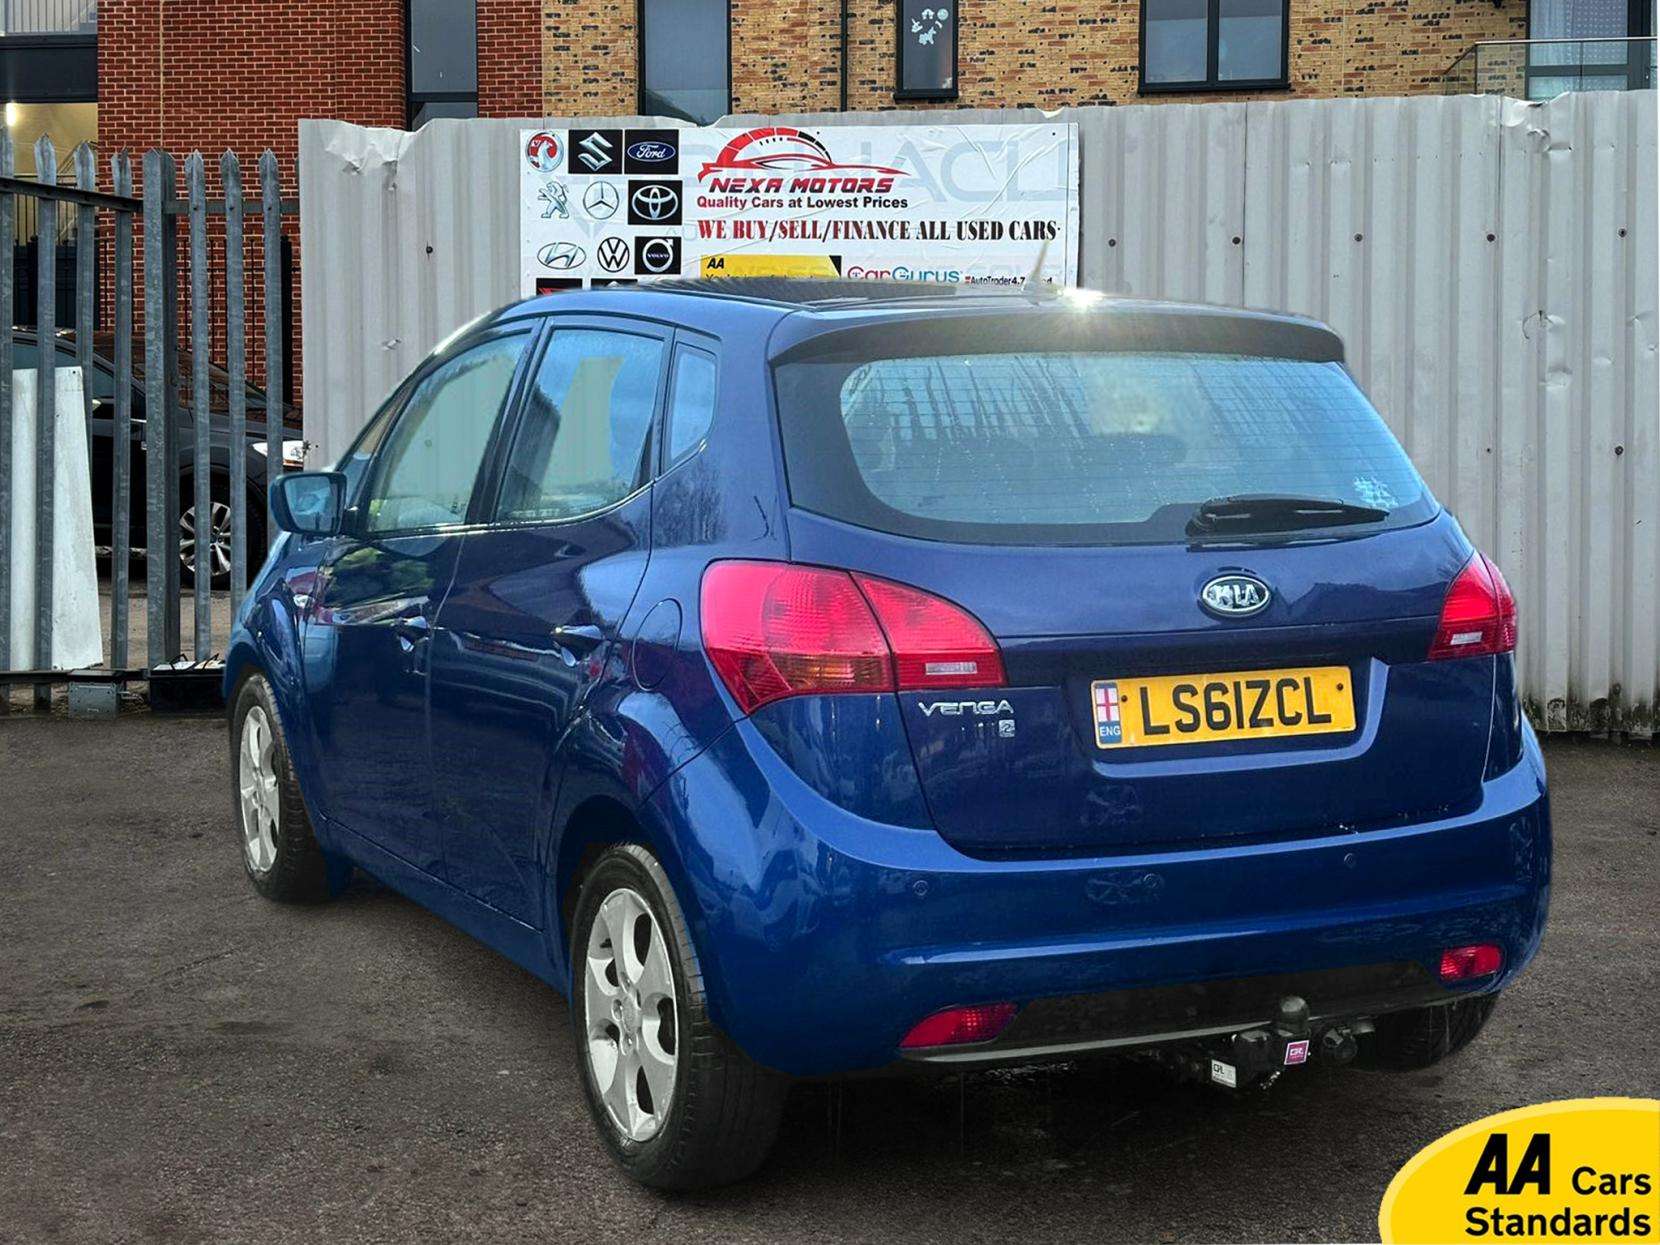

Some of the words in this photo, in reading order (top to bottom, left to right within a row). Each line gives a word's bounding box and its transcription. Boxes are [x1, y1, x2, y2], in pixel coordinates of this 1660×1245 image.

[636, 144, 666, 158] Ford
[708, 177, 784, 194] NEXA
[789, 177, 894, 194] MOTORS
[697, 196, 747, 210] Quality
[751, 196, 784, 208] Cars
[788, 197, 802, 208] at
[807, 196, 858, 208] Lowest
[863, 196, 908, 208] Prices
[697, 219, 727, 240] WE
[733, 219, 911, 242] BUY/SELL/FINANCE
[915, 220, 951, 240] ALL
[957, 220, 1004, 240] USED
[1009, 220, 1057, 240] CARS
[707, 257, 725, 269] AA
[847, 266, 960, 282] CarGurus
[918, 700, 1014, 716] VENGA
[1099, 725, 1121, 737] ENG
